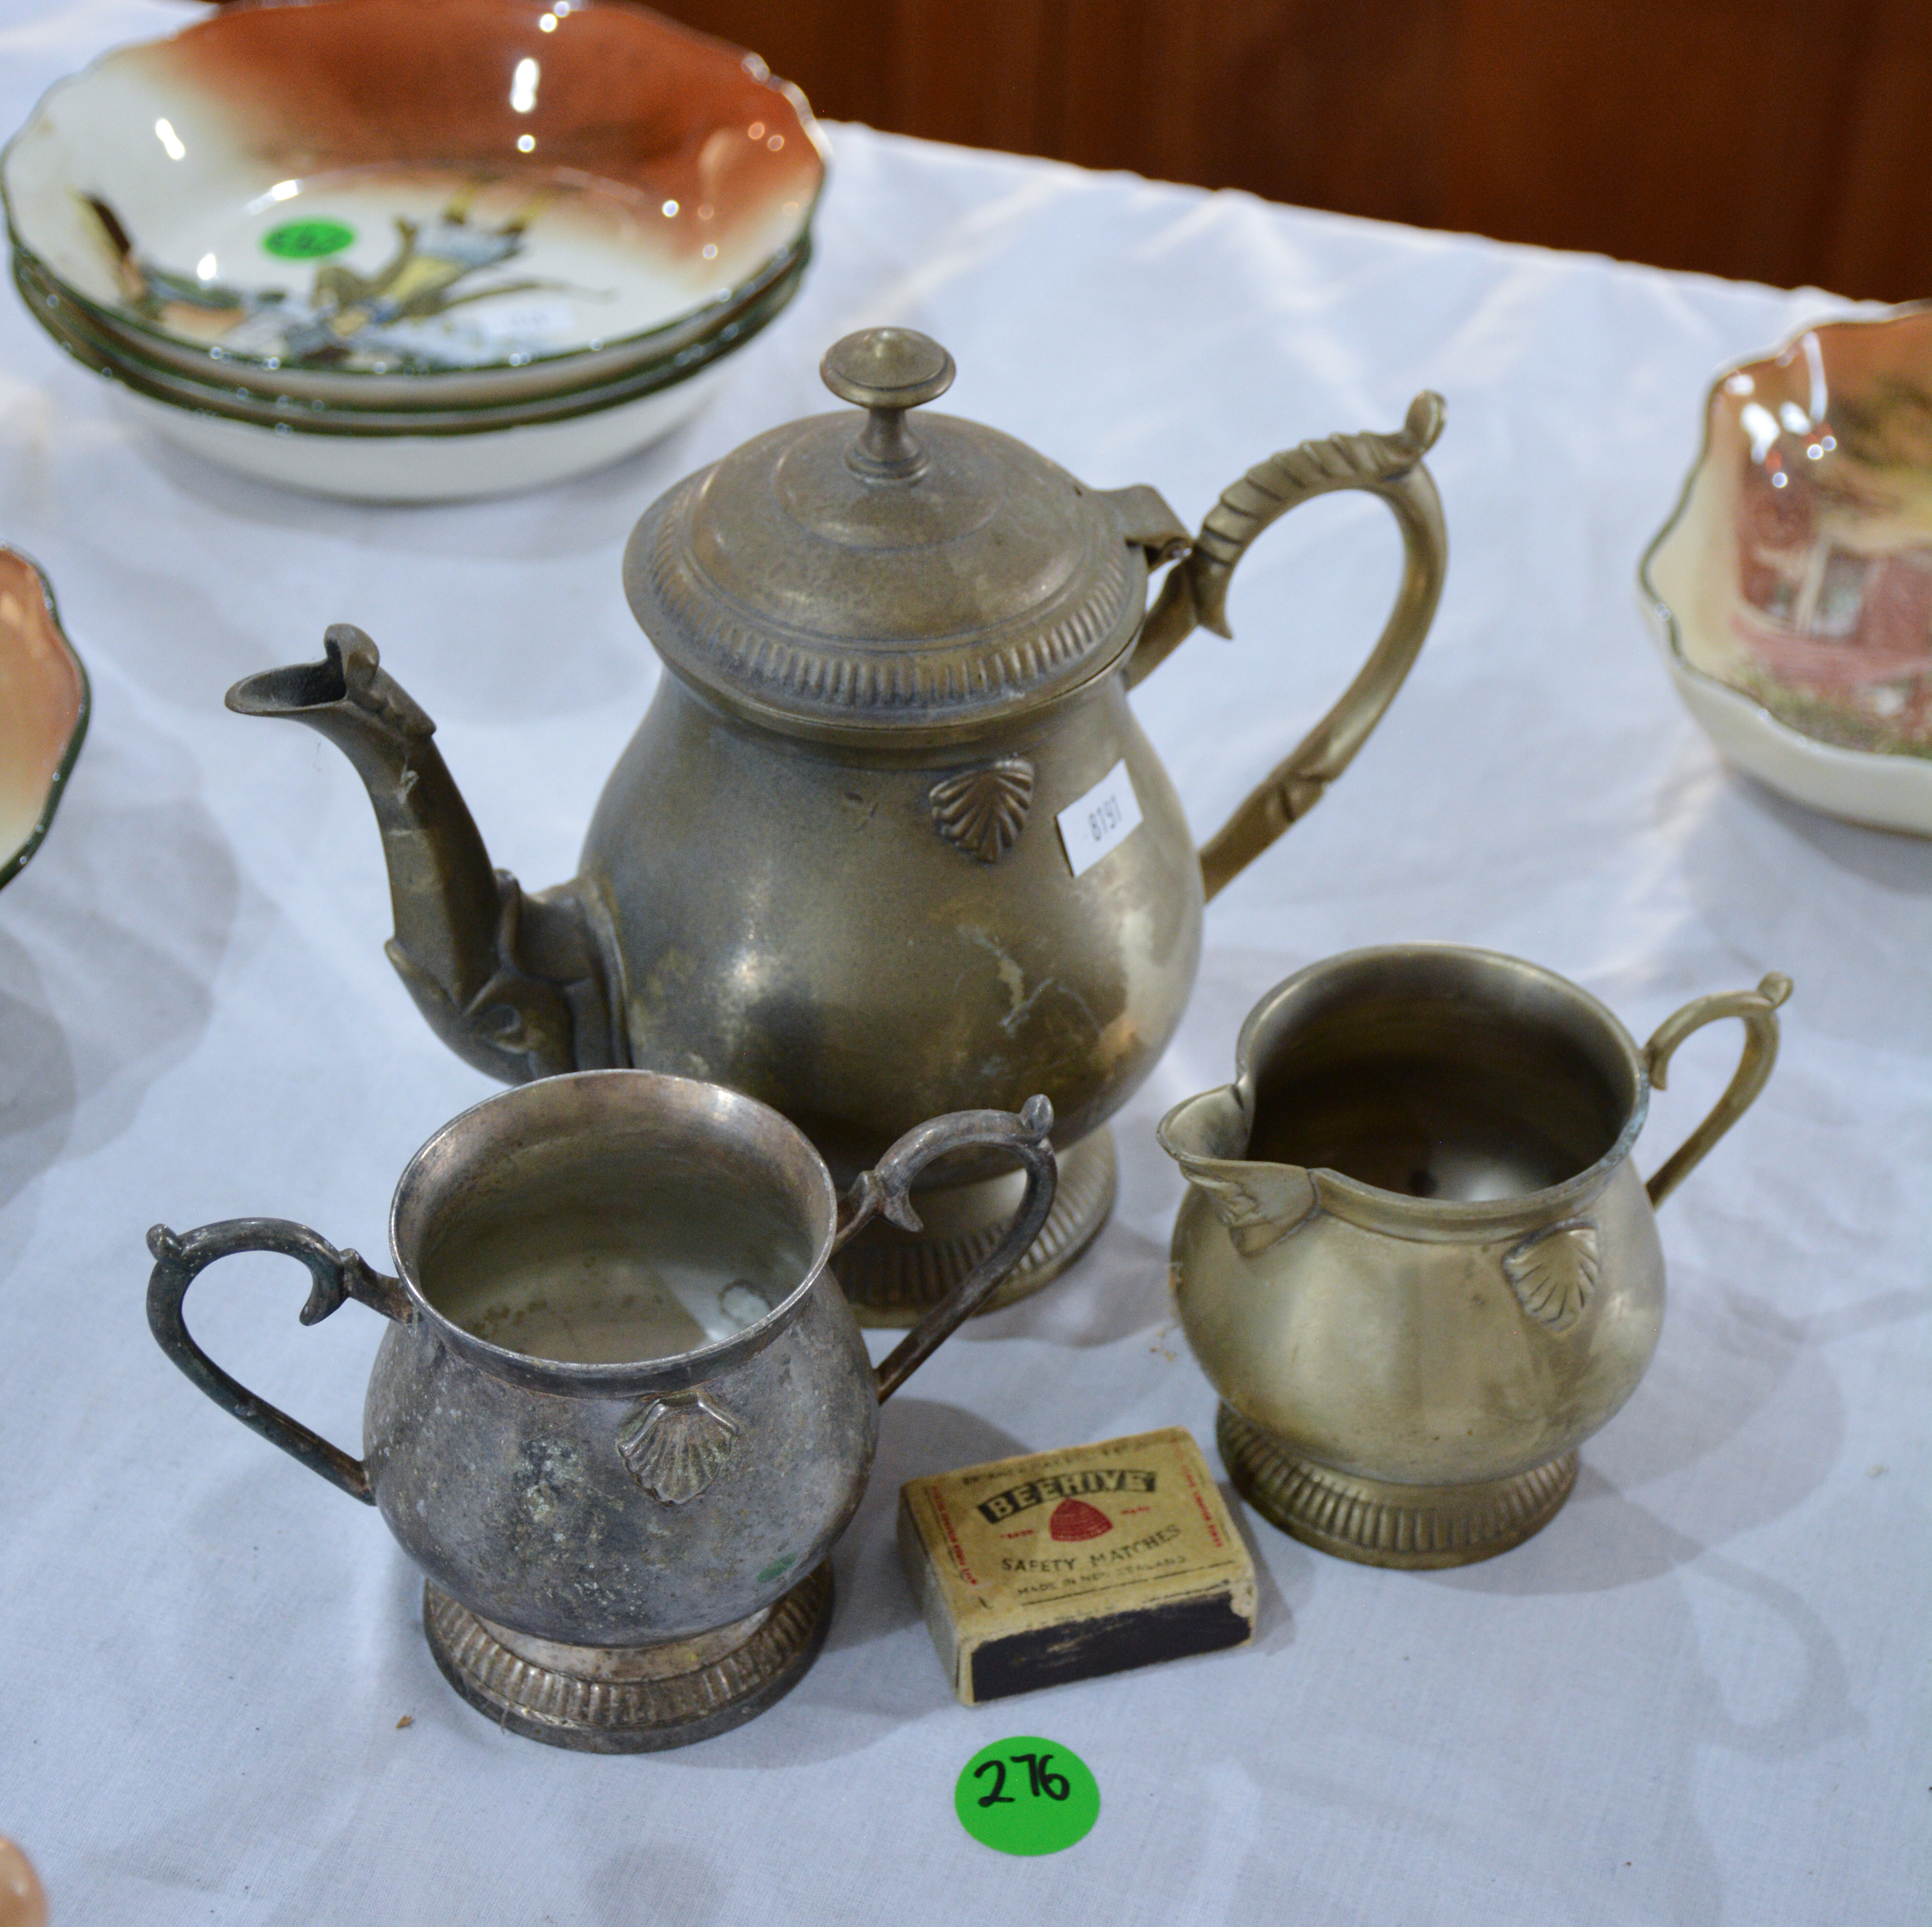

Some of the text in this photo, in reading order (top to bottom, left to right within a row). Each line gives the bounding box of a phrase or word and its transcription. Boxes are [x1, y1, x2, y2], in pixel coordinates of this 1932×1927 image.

[981, 1470, 1152, 1523] BEEHIVE
[1001, 1524, 1182, 1573] SAFETY MATCHES
[973, 1753, 1070, 1808] 276
